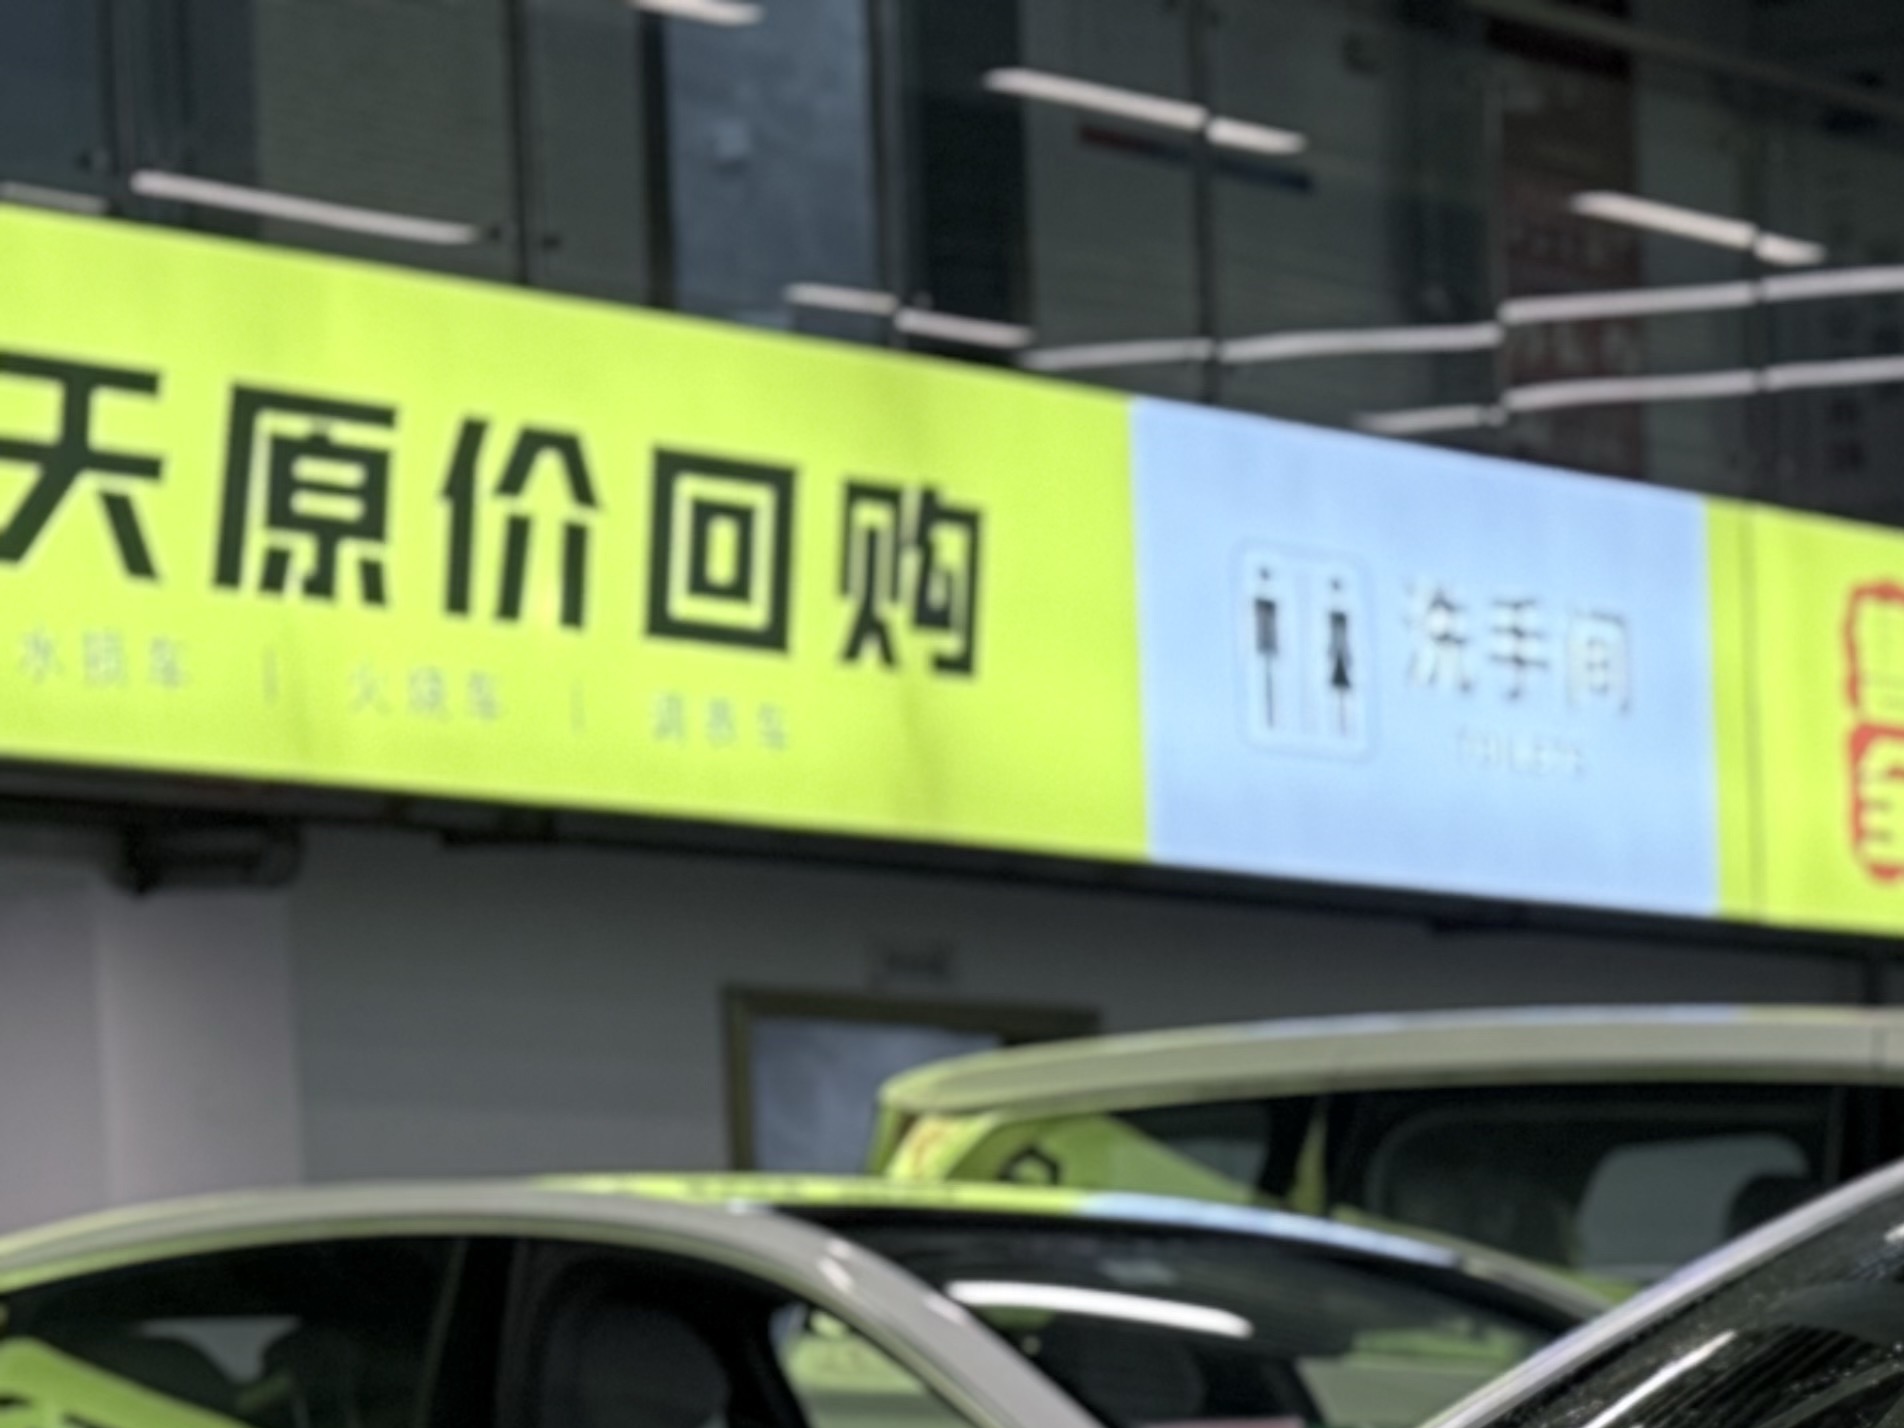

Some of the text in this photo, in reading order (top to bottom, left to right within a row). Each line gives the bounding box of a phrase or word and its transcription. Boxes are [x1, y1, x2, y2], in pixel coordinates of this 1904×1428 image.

[0, 348, 985, 678] 天原价回购
[1403, 576, 1634, 718] 洗手间
